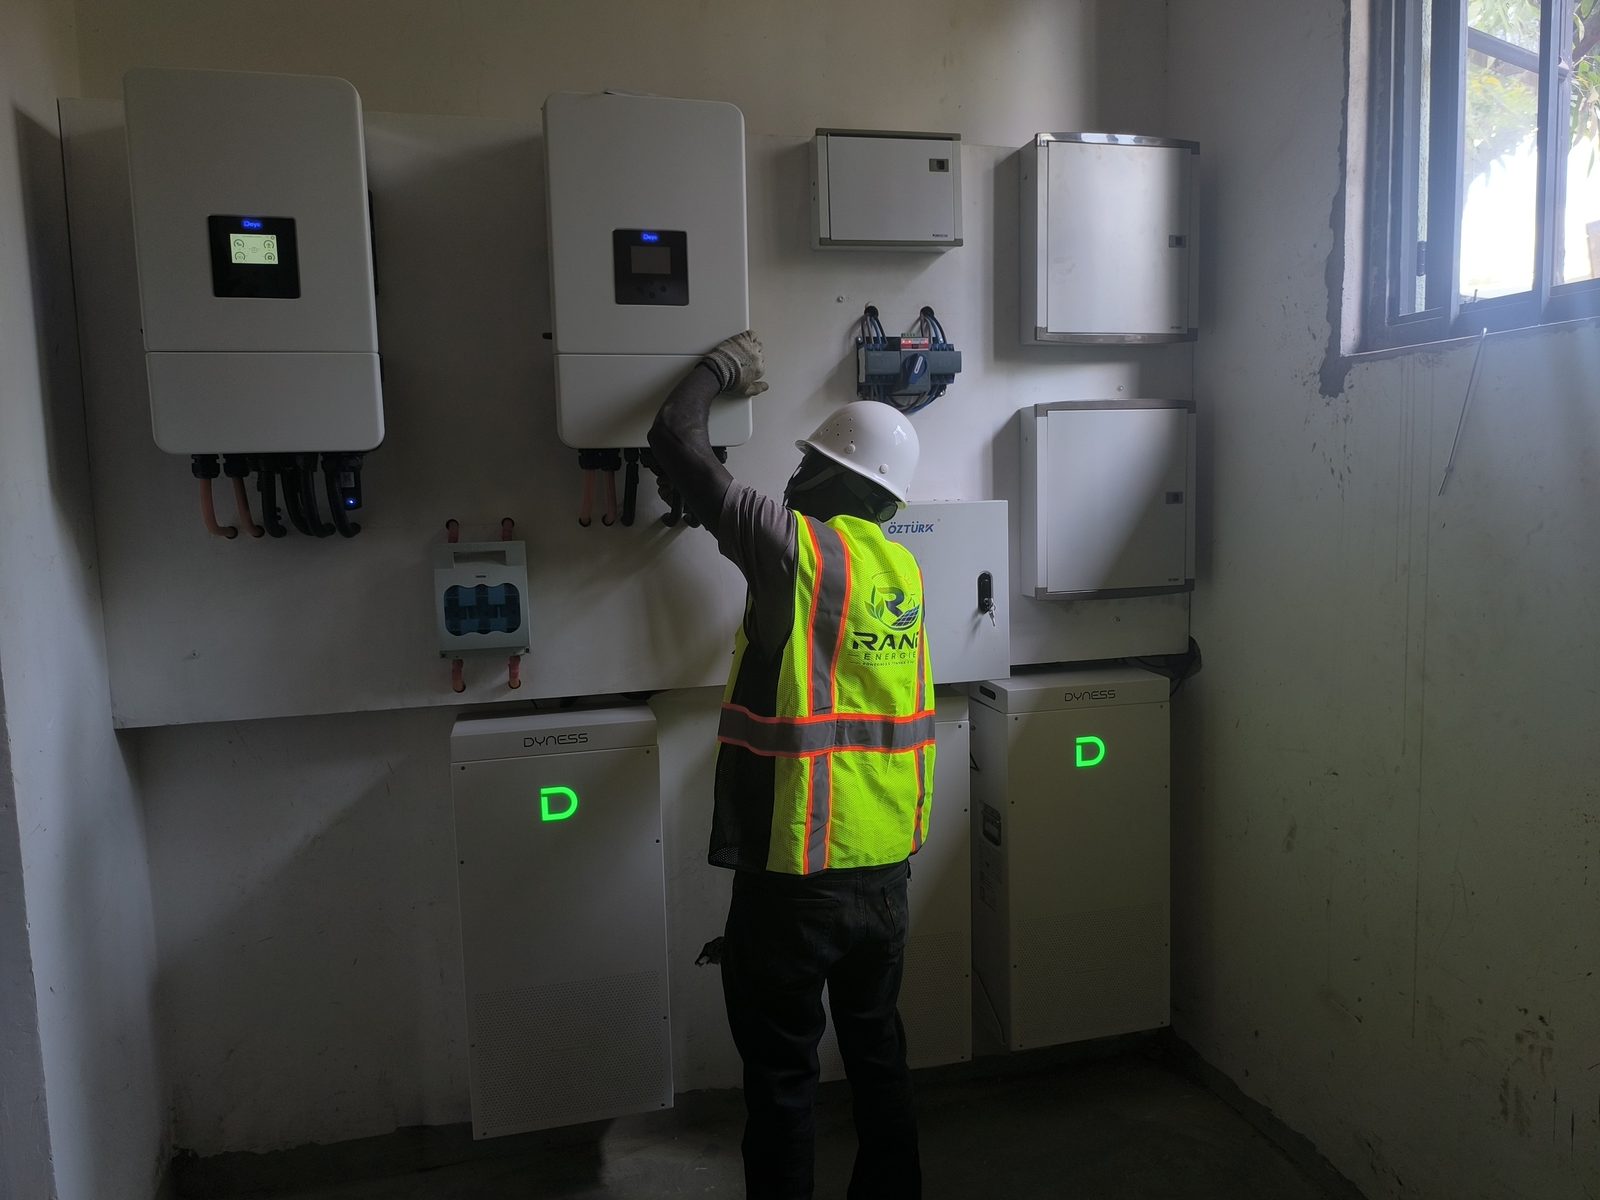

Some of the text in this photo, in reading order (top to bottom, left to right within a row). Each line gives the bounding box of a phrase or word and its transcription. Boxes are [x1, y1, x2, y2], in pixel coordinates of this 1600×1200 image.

[887, 521, 935, 535] ÖZTÜRK
[1064, 689, 1116, 702] DYNESS
[523, 732, 589, 748] DYNESS
[1075, 736, 1106, 768] D
[539, 785, 579, 822] D
